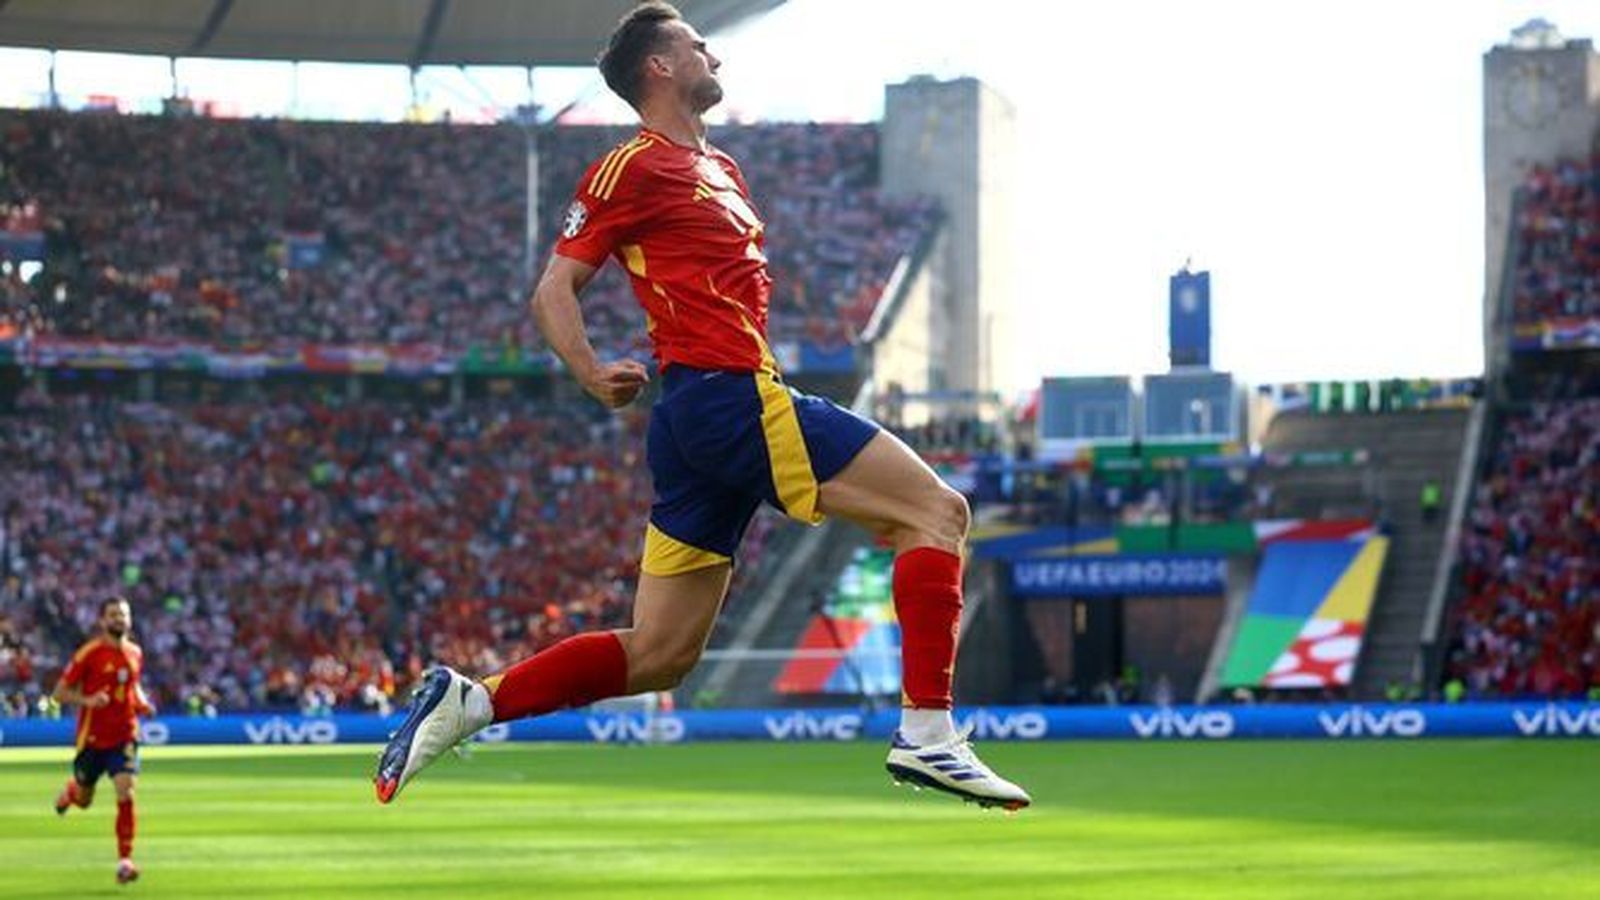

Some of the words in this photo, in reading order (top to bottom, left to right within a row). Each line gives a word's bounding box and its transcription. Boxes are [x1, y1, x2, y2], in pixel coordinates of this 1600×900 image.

[1014, 561, 1085, 585] UEFA
[1087, 560, 1166, 584] EURO
[244, 715, 338, 742] vivo
[586, 712, 685, 741] vivo
[1130, 706, 1235, 737] vivo
[1318, 705, 1425, 736] vivo
